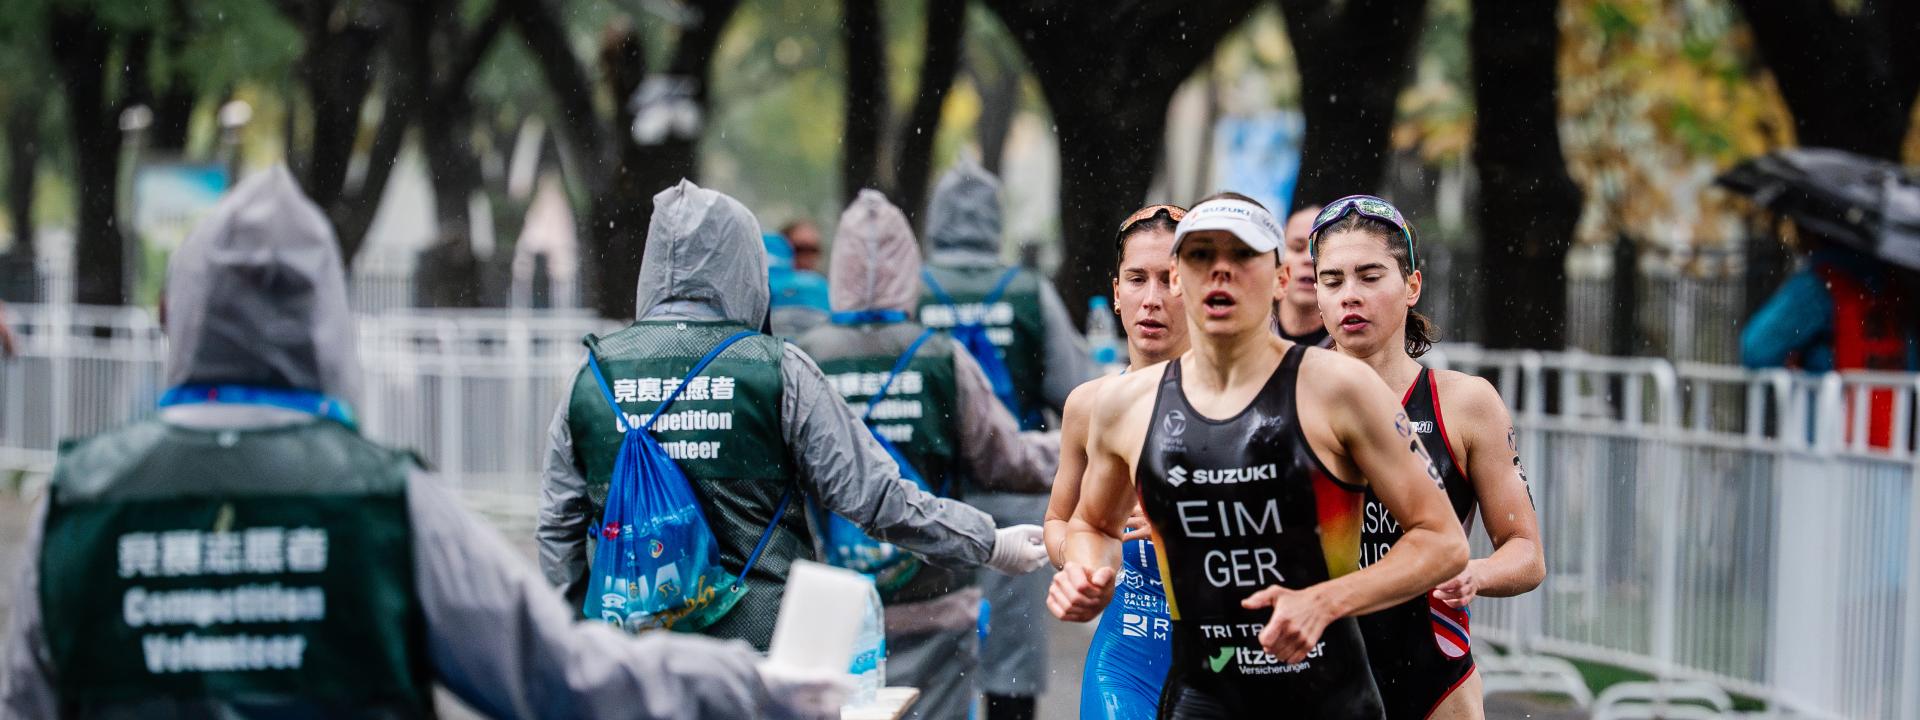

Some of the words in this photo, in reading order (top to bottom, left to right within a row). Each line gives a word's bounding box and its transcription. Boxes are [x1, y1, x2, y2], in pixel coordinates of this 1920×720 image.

[1201, 206, 1251, 216] SUZUKI
[614, 376, 735, 403] 竞赛志愿者
[658, 440, 721, 460] nteer
[1192, 463, 1277, 484] SUZUKI
[1176, 498, 1283, 538] EIM
[1204, 548, 1285, 588] GER
[123, 583, 326, 628] Competition
[1124, 592, 1157, 602] SPORT
[1124, 598, 1158, 608] VALLEY
[1200, 624, 1232, 638] TRI
[142, 633, 306, 673] Volunteer
[1236, 641, 1326, 665] Itzeer
[1238, 661, 1311, 675] Versicherungen
